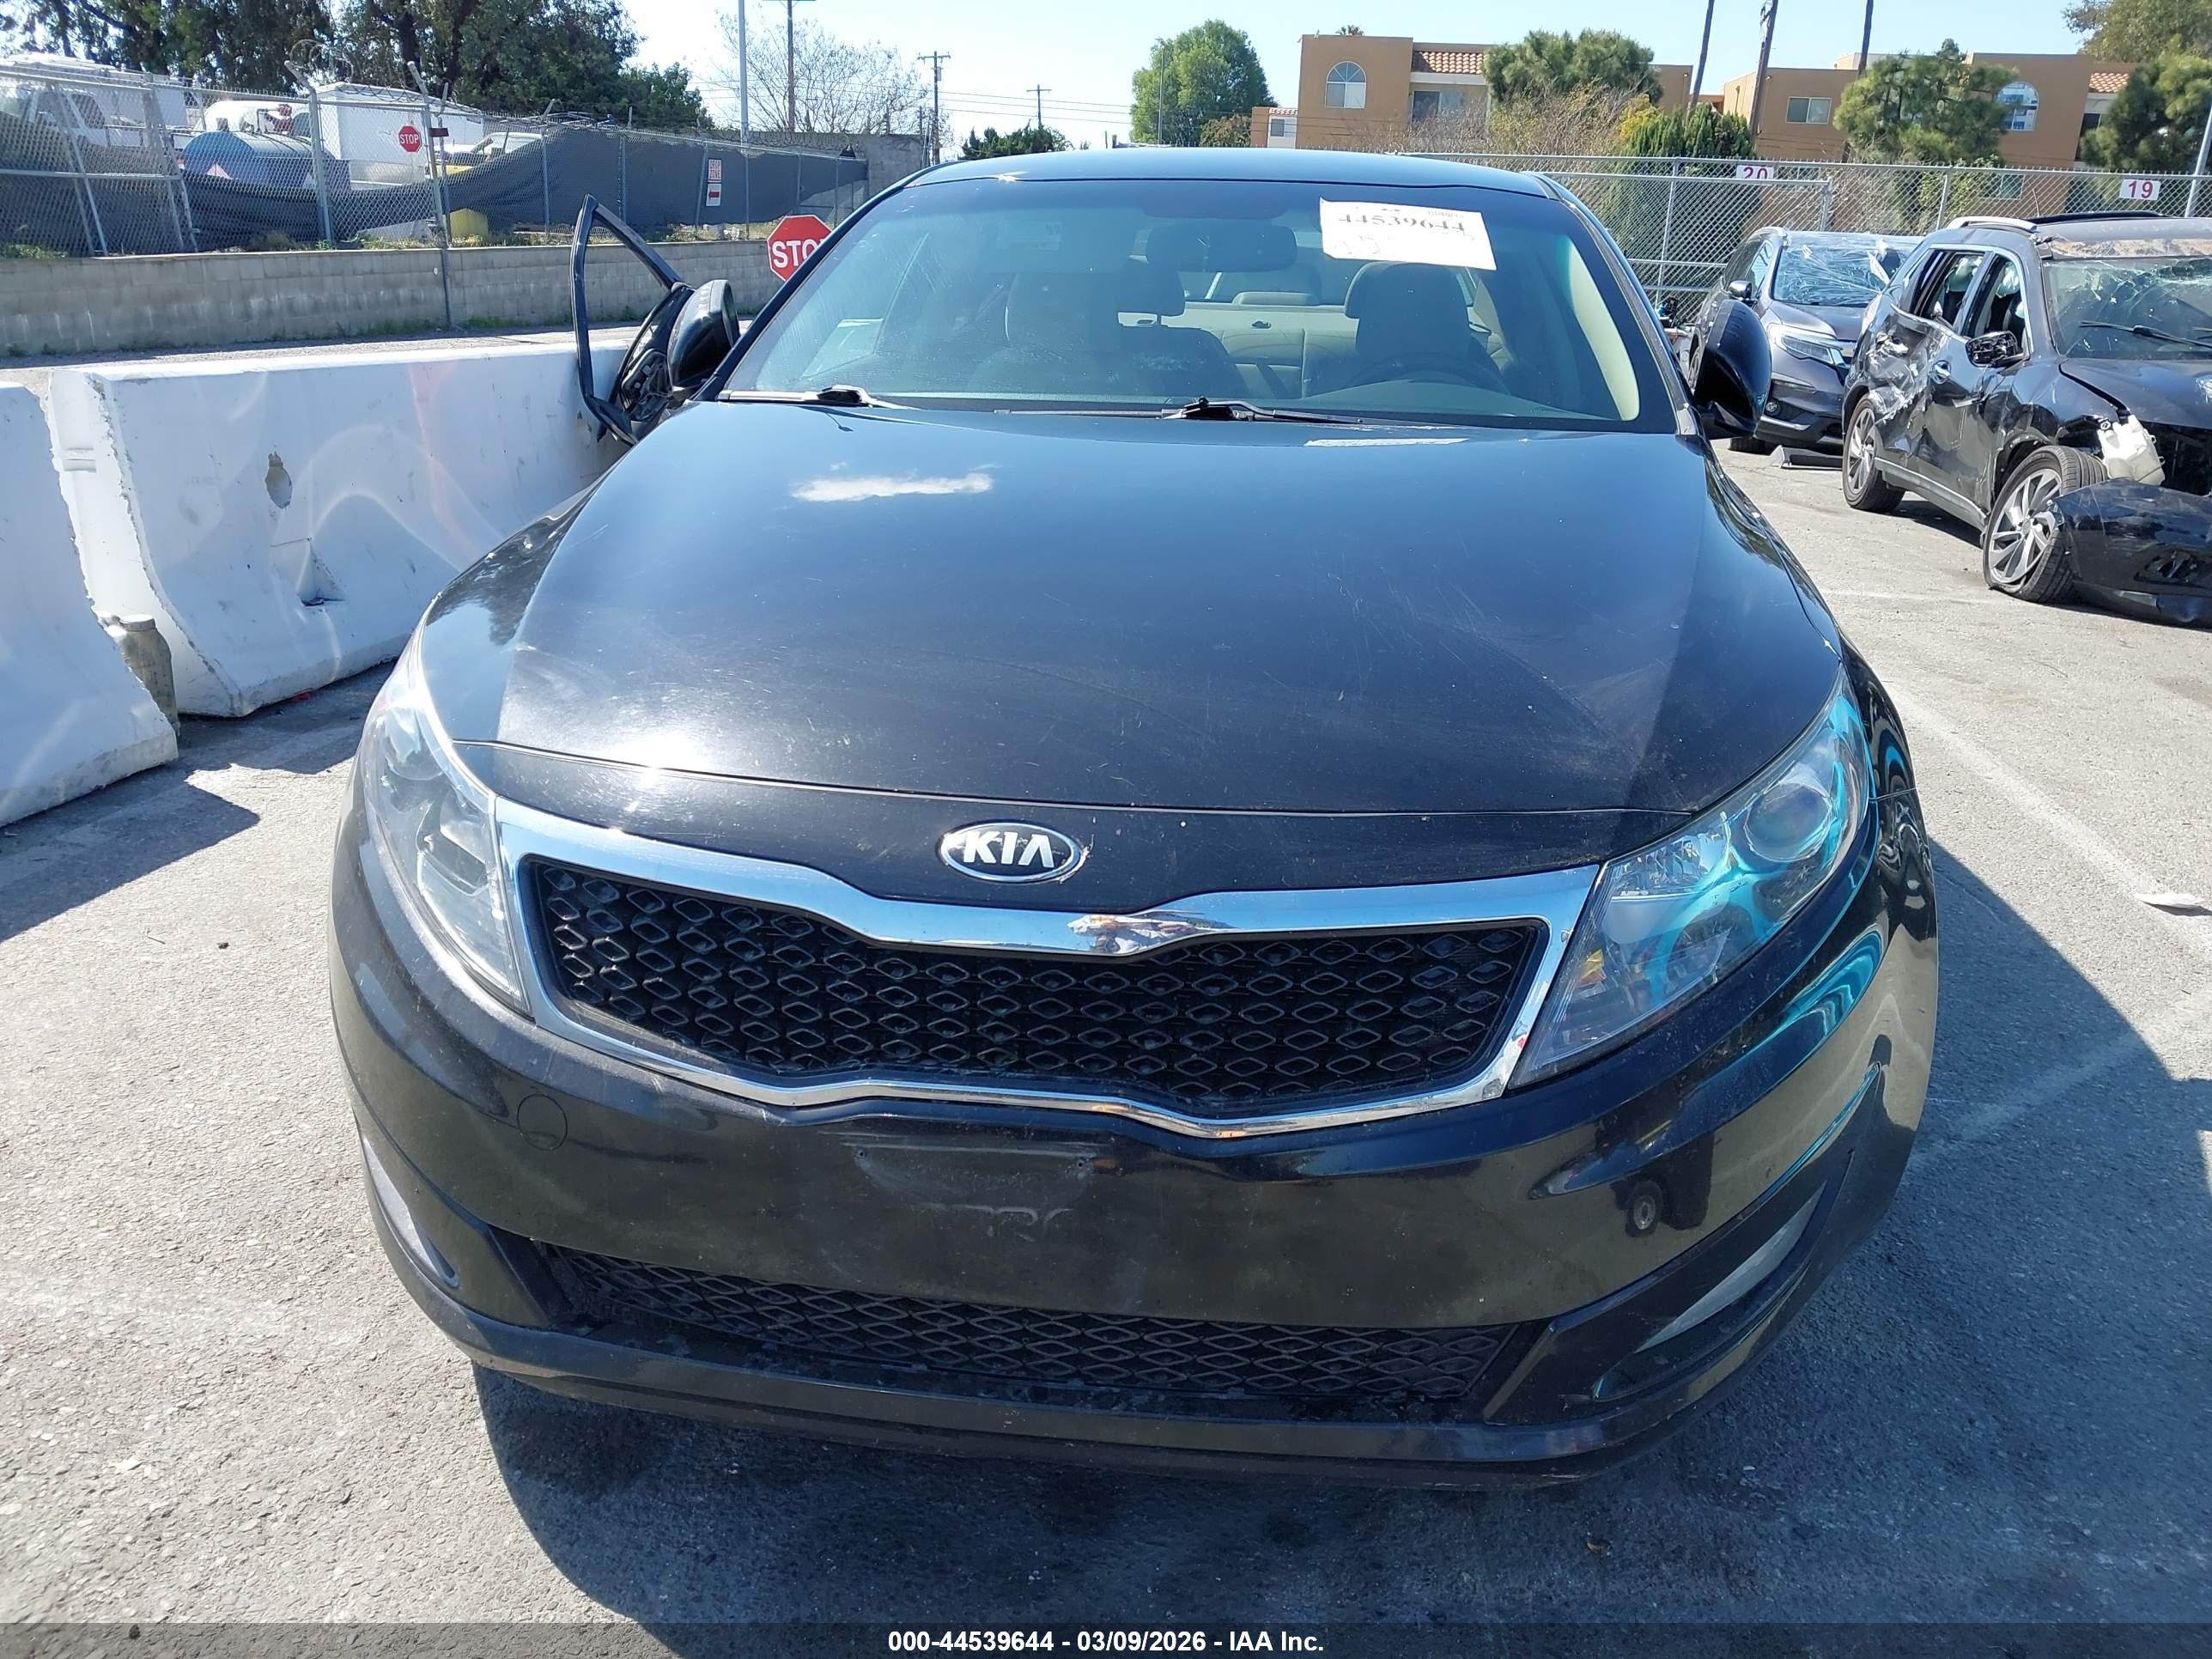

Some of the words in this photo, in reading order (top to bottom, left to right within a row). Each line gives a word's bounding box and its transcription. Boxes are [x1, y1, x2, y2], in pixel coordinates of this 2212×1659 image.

[399, 133, 419, 144] STOP
[1743, 167, 1767, 179] 20
[2129, 180, 2153, 198] 19
[773, 239, 825, 268] STO
[963, 830, 1054, 868] KIA
